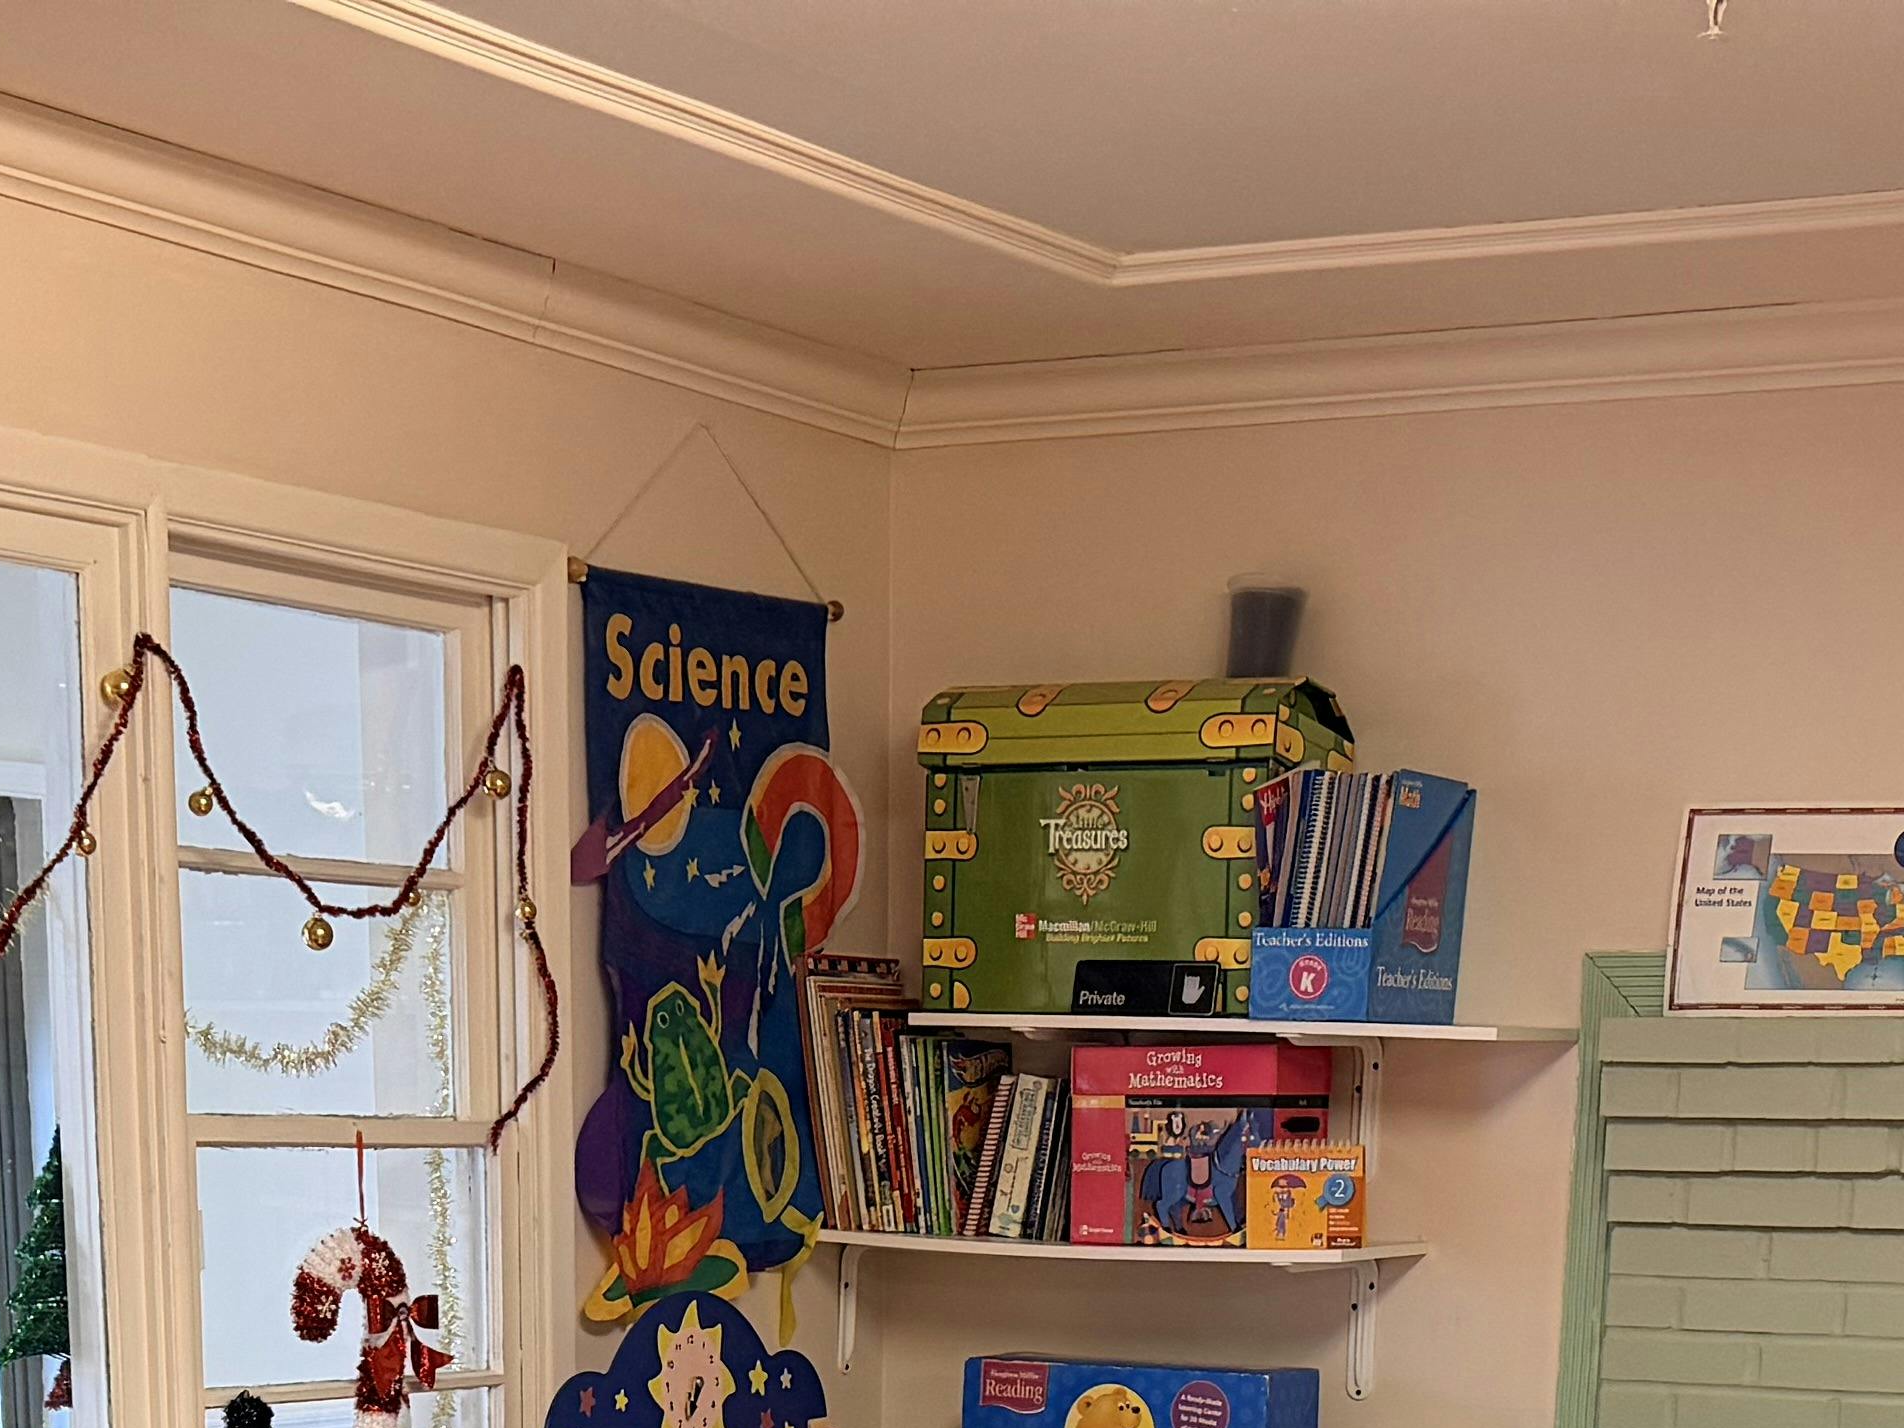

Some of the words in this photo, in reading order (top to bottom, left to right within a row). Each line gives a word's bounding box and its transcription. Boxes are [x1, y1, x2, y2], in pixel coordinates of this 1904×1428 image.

[606, 612, 809, 708] Science
[1039, 818, 1128, 855] Treasures
[1725, 898, 1752, 907] States
[1255, 932, 1311, 947] Teacher's
[1316, 934, 1368, 947] Editions
[1377, 966, 1417, 988] Teacher's
[1418, 969, 1453, 991] Editions
[1079, 990, 1126, 1006] Private
[1146, 1049, 1202, 1067] Growing
[1128, 1072, 1224, 1090] Mathematics
[985, 1379, 1043, 1402] Reading
